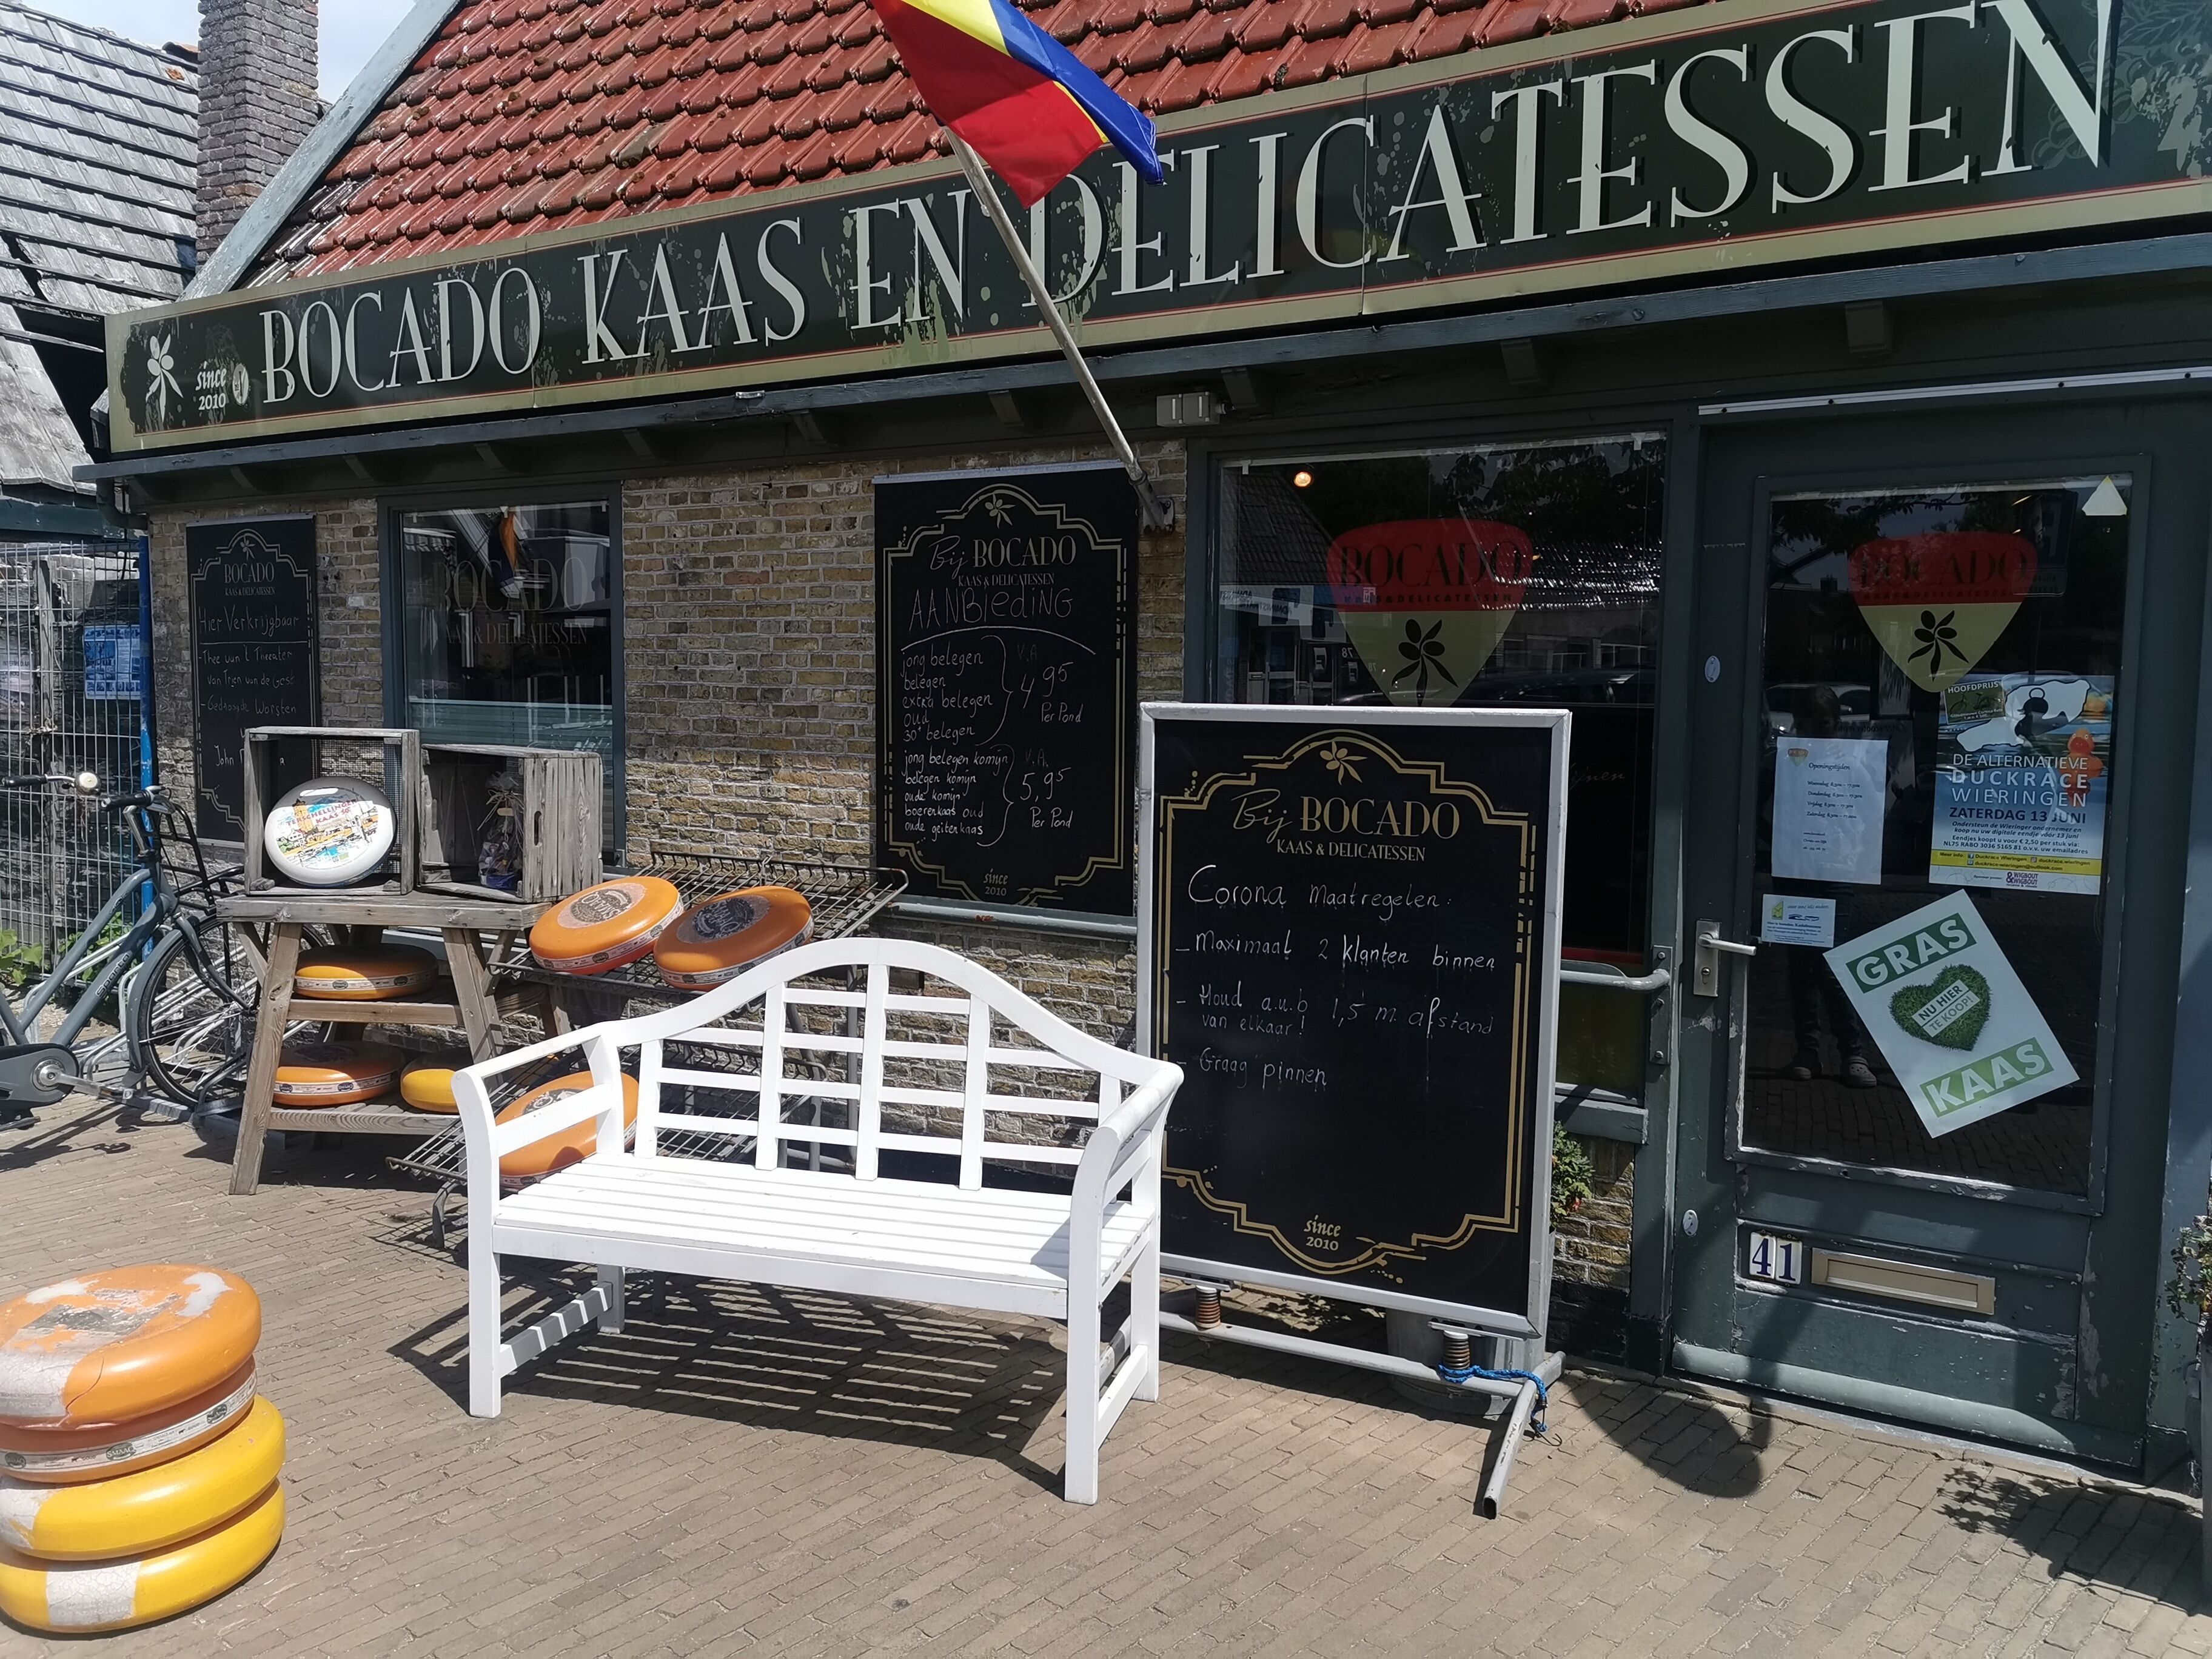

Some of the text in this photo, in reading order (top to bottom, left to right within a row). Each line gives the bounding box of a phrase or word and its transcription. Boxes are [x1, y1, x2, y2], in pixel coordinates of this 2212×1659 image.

[259, 0, 2116, 404] BOCADO KAAS EN DELICATESSEN
[195, 362, 227, 391] since
[198, 393, 227, 411] 2010
[928, 535, 1076, 579] Bij BOCADO
[1341, 541, 1522, 588] BOCADO
[224, 562, 274, 583] BOCADO
[958, 573, 1055, 586] KAAS & DELICATESSEN
[225, 587, 238, 596] KAAS
[243, 586, 275, 595] DELICATESSEN
[432, 557, 588, 612] BOCADO
[199, 605, 299, 637] Hier Verkrijgbaar
[486, 623, 588, 645] DELICATESSEN
[225, 654, 241, 663] van
[900, 642, 984, 677] jong belegen
[261, 674, 270, 685] de
[904, 675, 946, 699] belegen
[1948, 680, 1999, 694] HOOFDPRIJS
[255, 699, 297, 716] Worsten
[942, 688, 993, 718] belegen
[1041, 702, 1084, 723] Per Pond
[926, 721, 976, 745] belegen
[215, 745, 234, 766] John
[901, 750, 925, 776] jong
[929, 748, 968, 773] belegen
[1808, 762, 1850, 771] Openingstijden
[1953, 754, 2088, 770] DE ALTERNATIEVE
[905, 769, 940, 795] belegen
[1951, 770, 2087, 789] DUCKRACE
[904, 788, 925, 801] oude
[1952, 788, 2086, 808] WIERINGEN
[286, 799, 357, 826] TERSCHELLINGER
[315, 813, 340, 823] KAAS
[905, 802, 984, 817] boerenkaas oud
[1030, 806, 1073, 828] Per Pond
[1231, 788, 1460, 843] Bij BOCADO
[1949, 807, 2086, 823] ZATERDAG 13 JUNI
[905, 821, 984, 842] oude geitenkaas
[1276, 838, 1426, 862] KAAS & DELICATESSEN
[983, 868, 1008, 885] since
[1188, 864, 1287, 906] Corona
[985, 886, 1007, 896] 2010
[1195, 930, 1292, 954] Maximaal
[1318, 938, 1329, 960] 2
[1432, 944, 1495, 969] binnen
[1856, 919, 1968, 985] GRAS
[95, 951, 131, 999] Sparta
[1199, 980, 1243, 1008] Houd
[1332, 998, 1366, 1027] 1,5
[1408, 997, 1492, 1035] afstand
[1918, 985, 1963, 1021] NU HIER
[1928, 995, 1972, 1031] TE KOOP!
[1202, 1014, 1227, 1029] van
[1199, 1047, 1327, 1090] Graag pinnen
[1926, 1044, 2045, 1112] KAAS
[1304, 1215, 1341, 1238] since
[1305, 1237, 1339, 1252] 2010
[1751, 1238, 1797, 1282] 41
